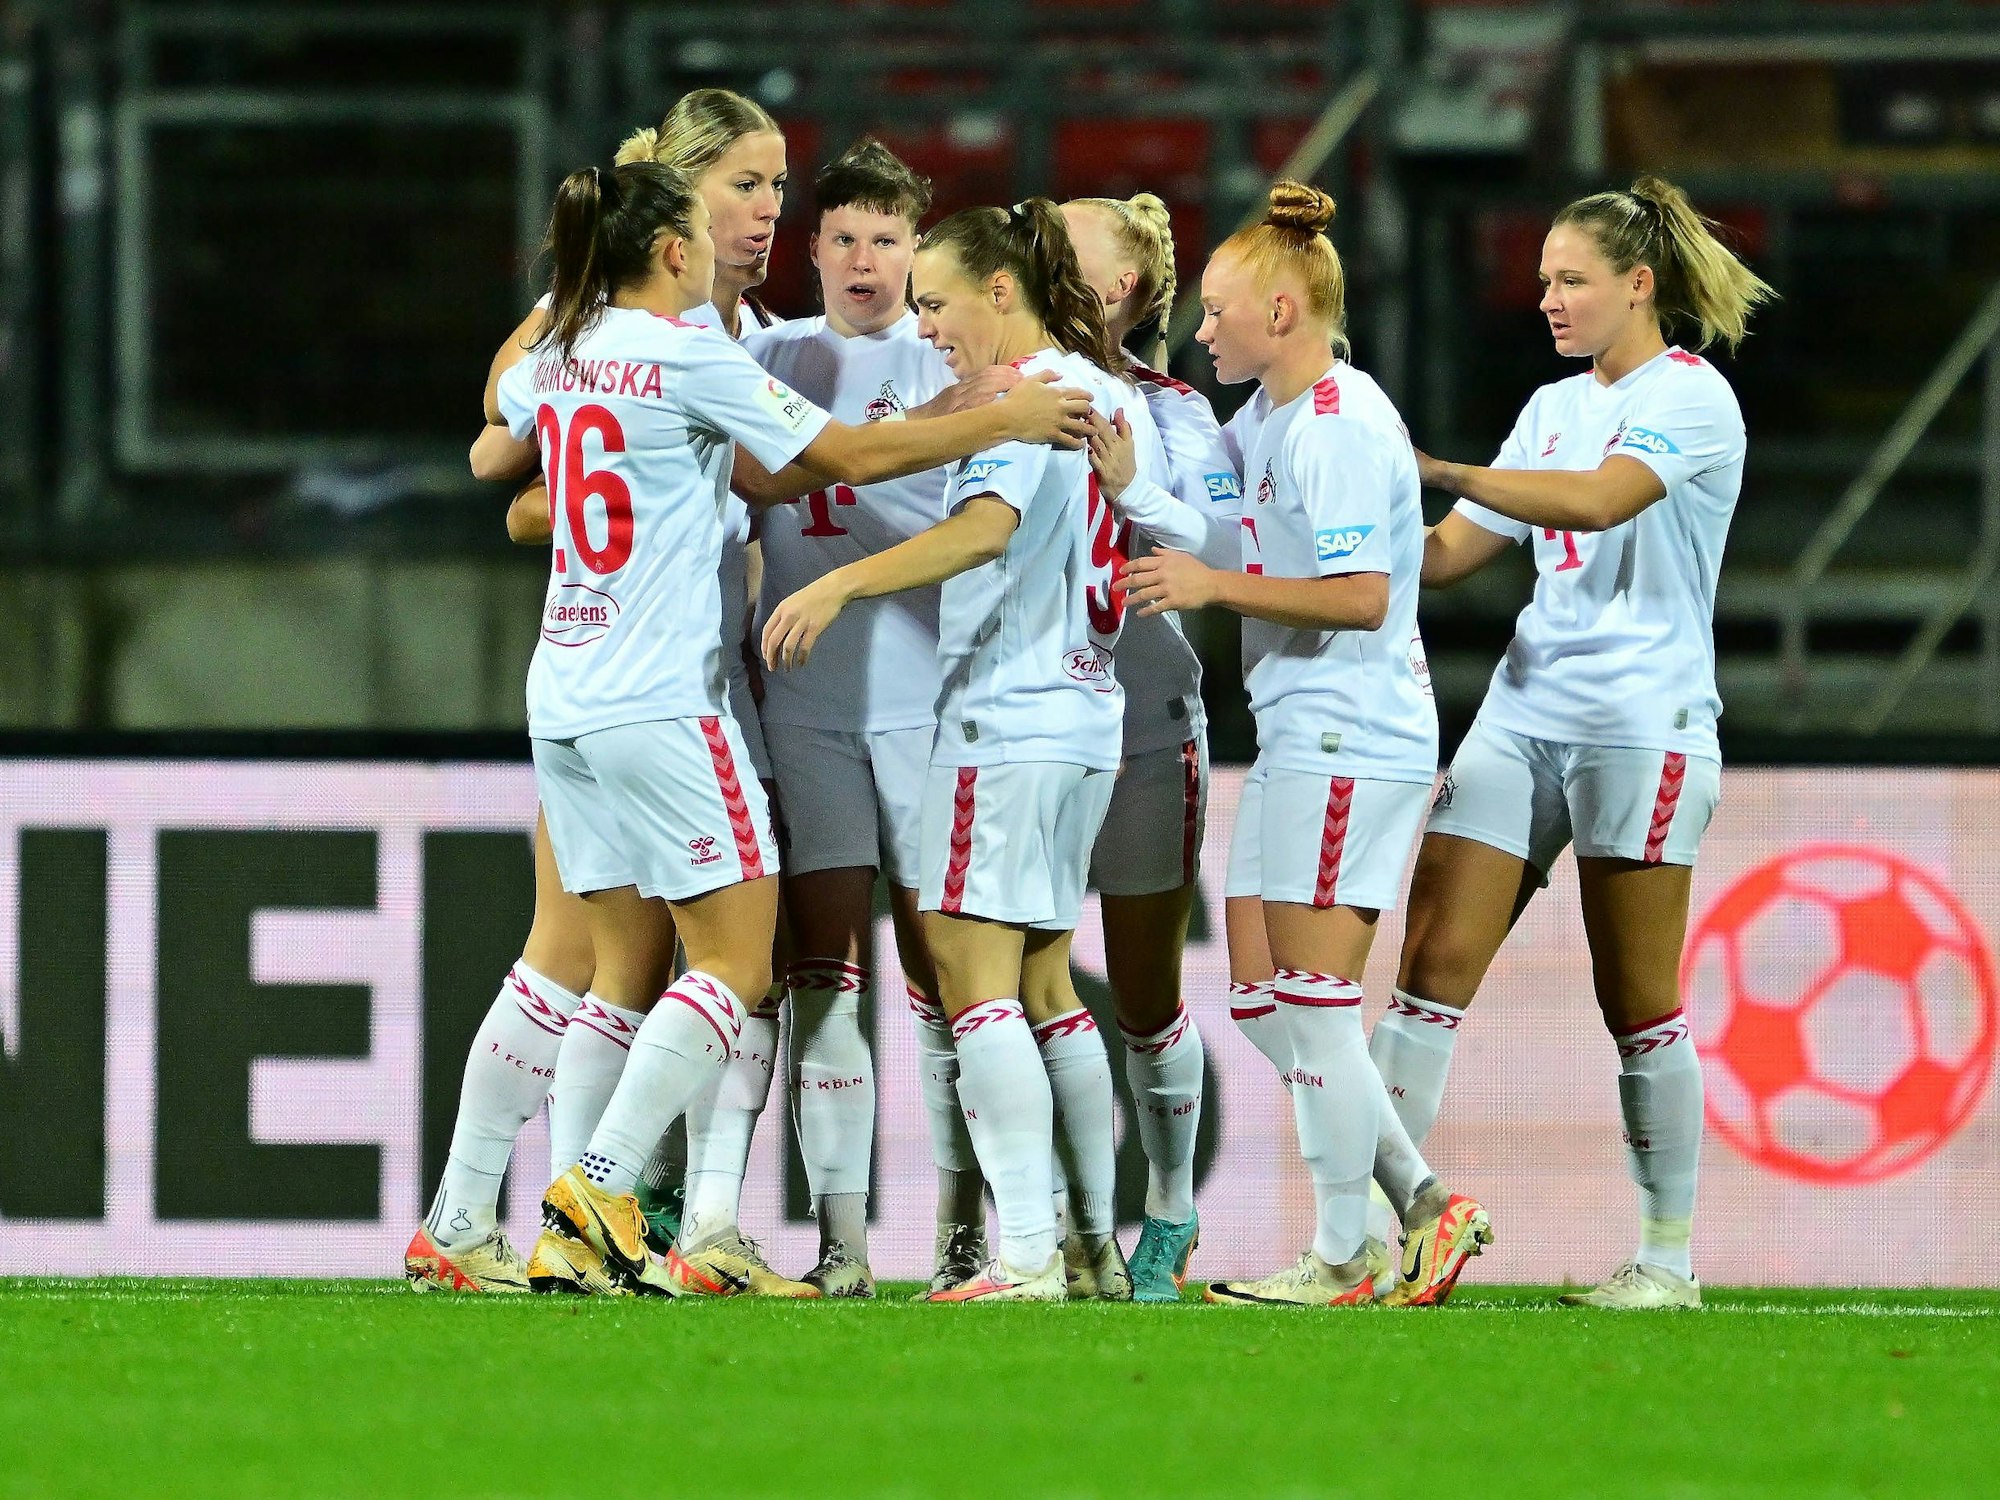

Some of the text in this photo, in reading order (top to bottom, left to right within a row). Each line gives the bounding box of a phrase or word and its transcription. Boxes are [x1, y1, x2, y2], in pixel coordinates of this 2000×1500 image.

[1626, 431, 1669, 453] SAP
[1317, 531, 1363, 556] SAP
[690, 852, 722, 866] hummel
[505, 1053, 527, 1070] FC
[817, 1076, 864, 1090] KÖLN
